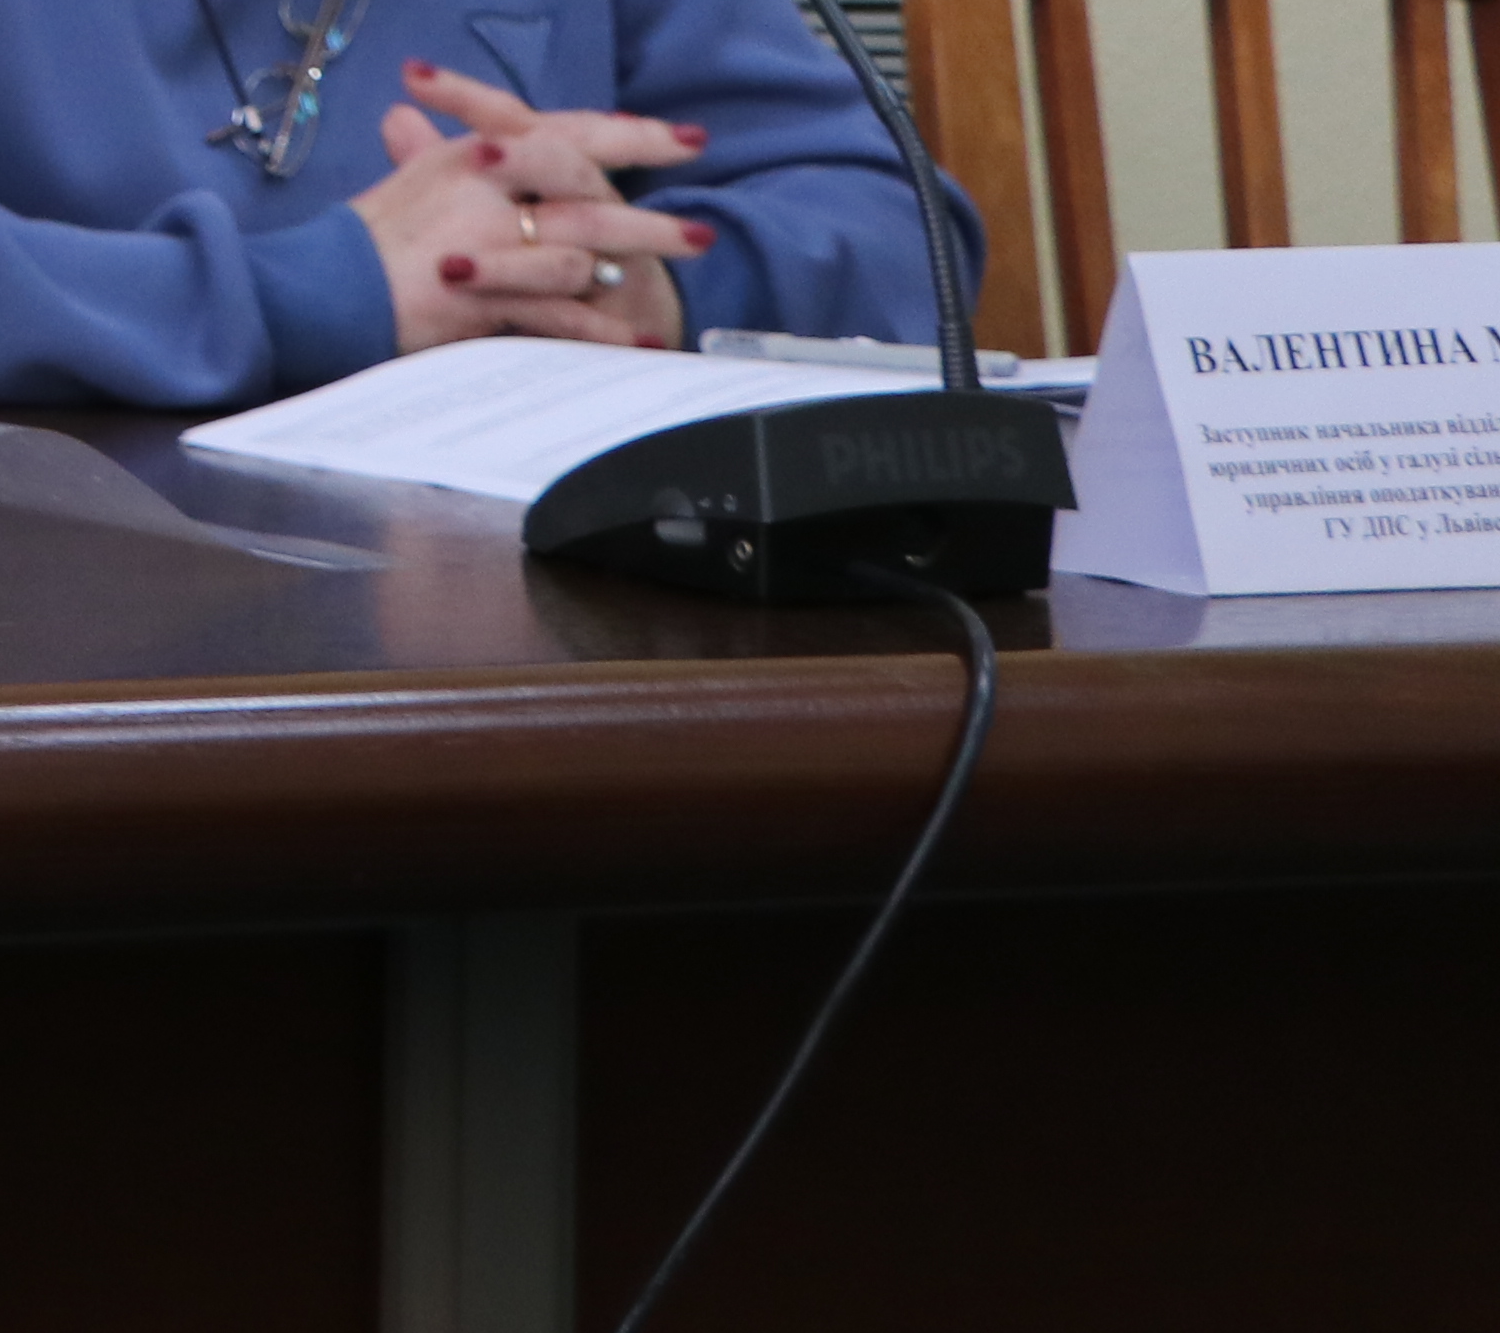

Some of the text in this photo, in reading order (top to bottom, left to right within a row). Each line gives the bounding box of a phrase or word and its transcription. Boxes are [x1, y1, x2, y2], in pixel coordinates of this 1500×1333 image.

[1185, 328, 1478, 374] ВАЛЕНТИНА
[1199, 413, 1500, 447] Заступник начальника відді
[820, 426, 1026, 485] PHILIPS
[1208, 458, 1330, 482] юридичних
[1334, 450, 1375, 471] осіб
[1378, 455, 1390, 475] у
[1397, 447, 1459, 472] галузі
[1242, 486, 1365, 513] управління
[1323, 517, 1353, 539] ГУ
[1362, 514, 1411, 540] ДПС
[1416, 520, 1428, 540] у
